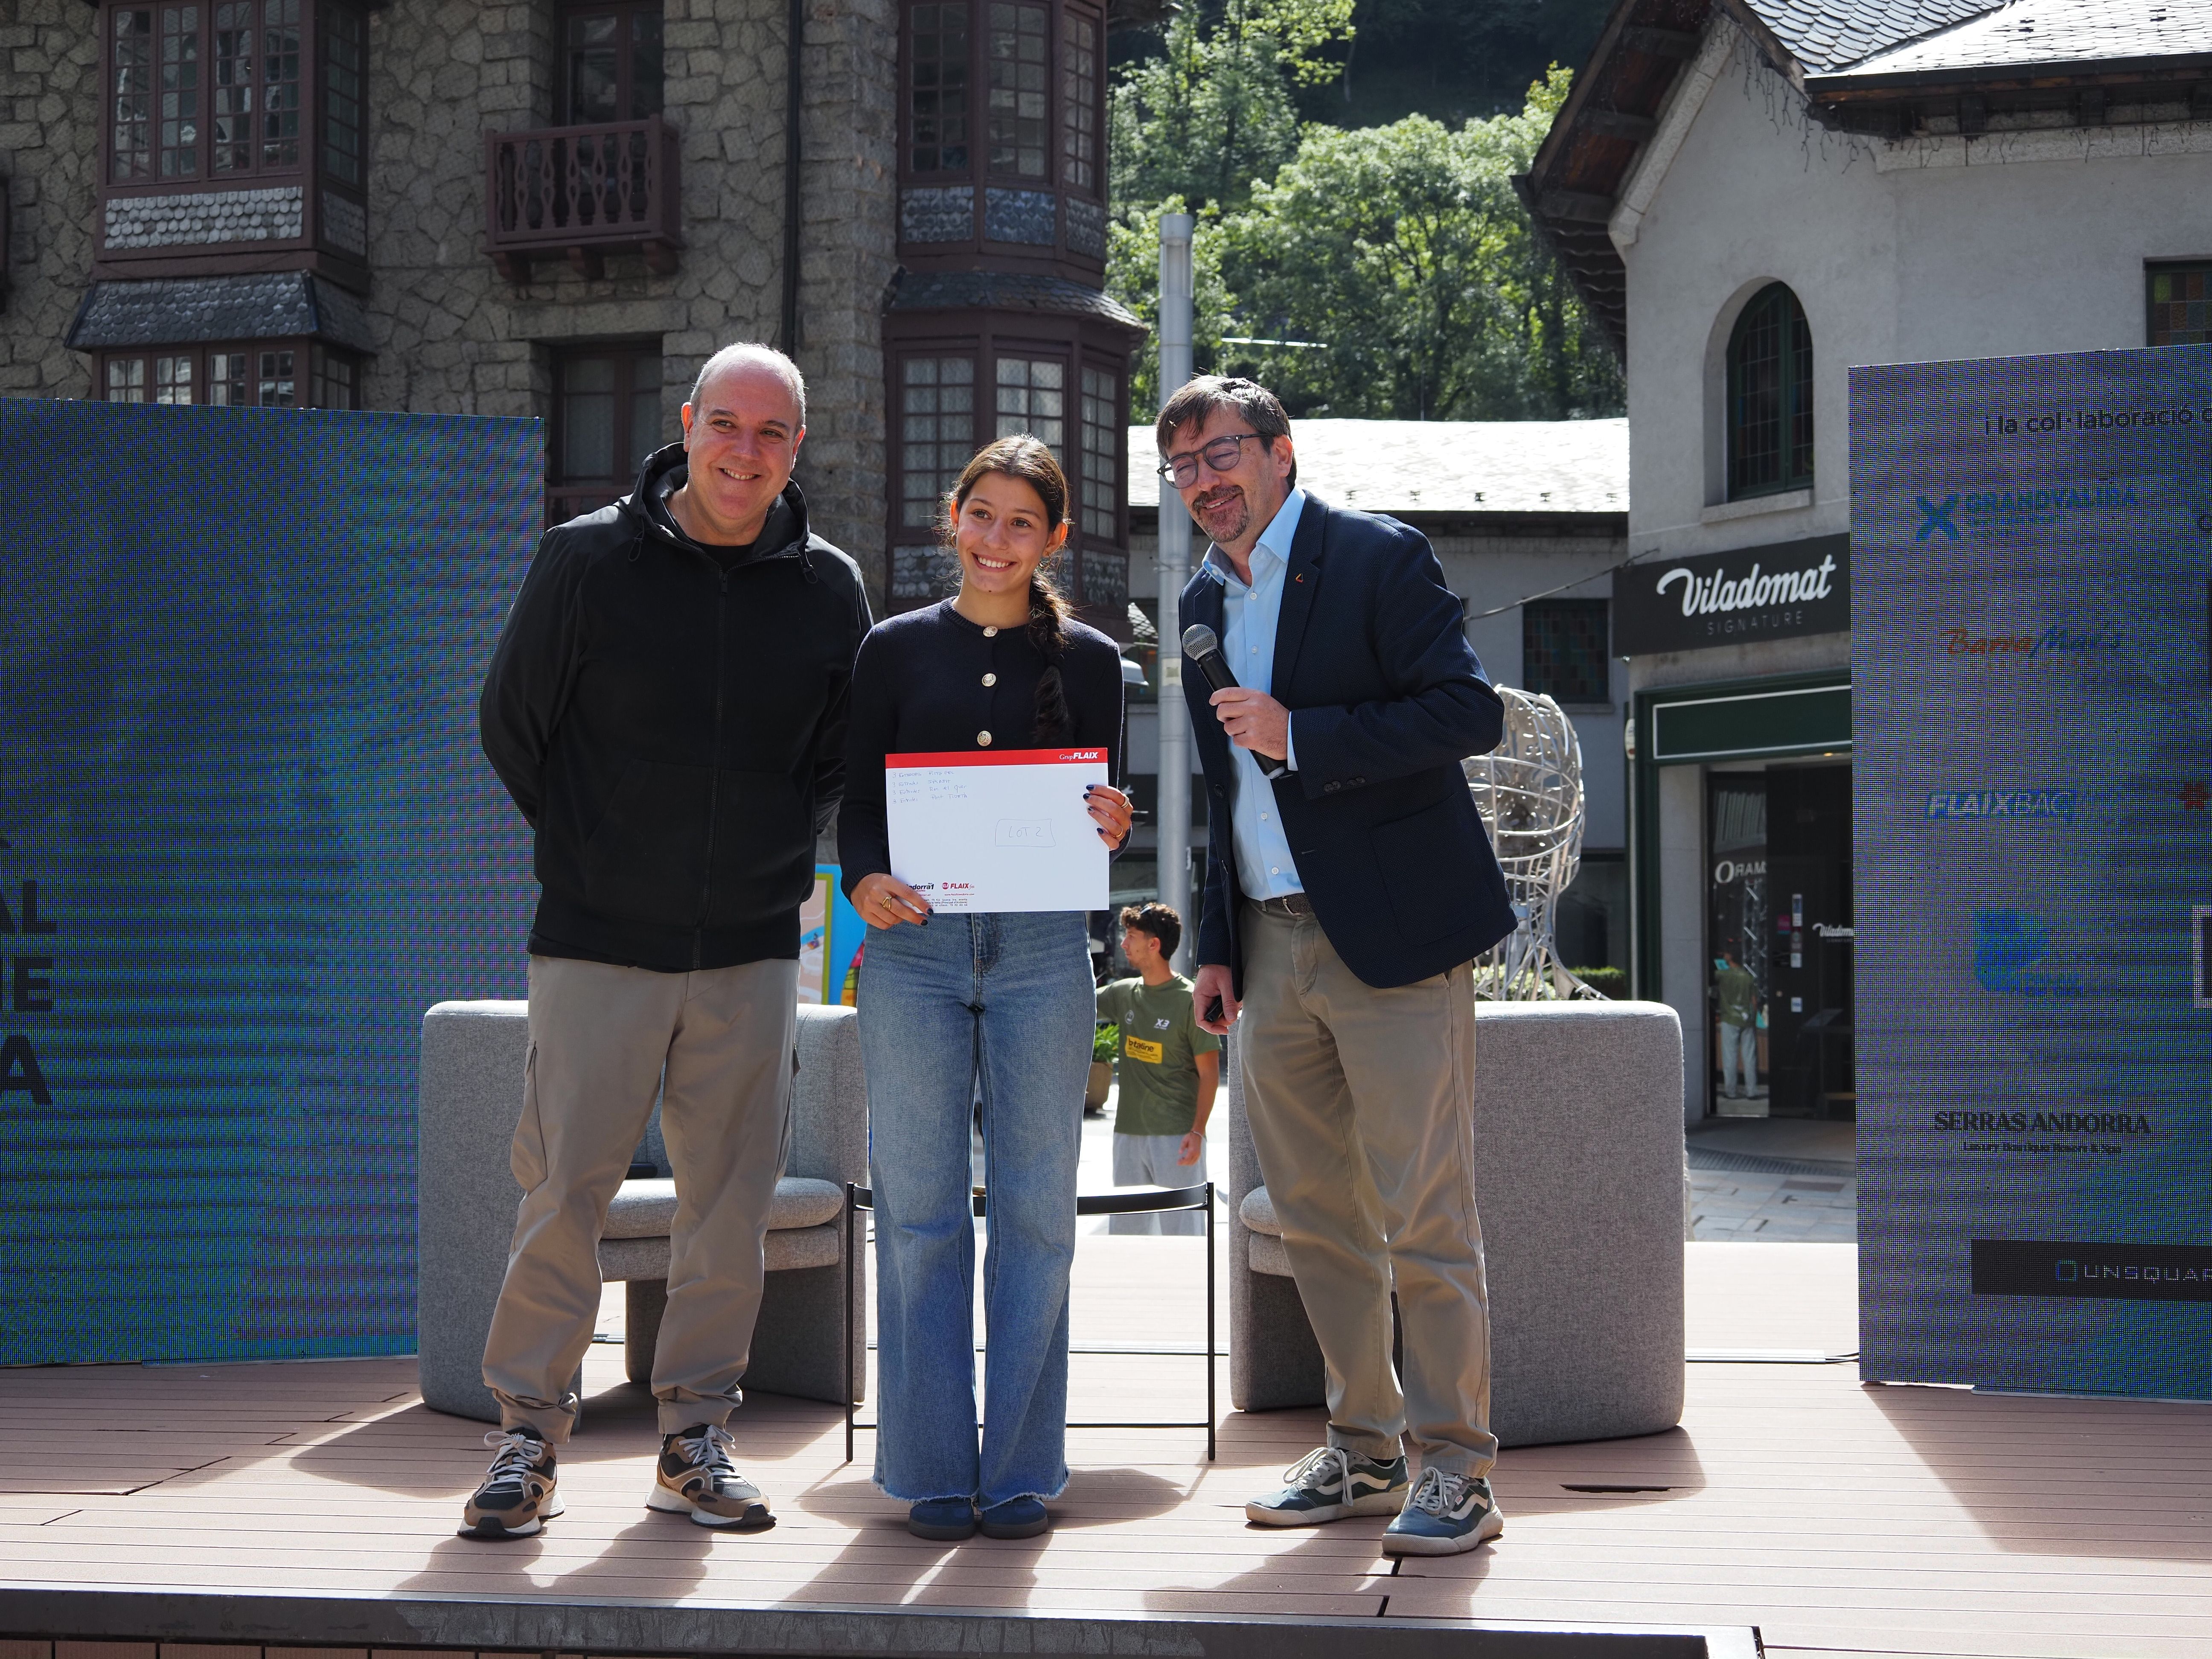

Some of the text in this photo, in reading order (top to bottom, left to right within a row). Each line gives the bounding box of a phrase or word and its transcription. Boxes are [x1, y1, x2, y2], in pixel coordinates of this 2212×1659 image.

[1998, 416, 2017, 434] la
[1964, 486, 2139, 514] GRANDVALIRA
[1656, 553, 1837, 617] Viladomat
[1707, 610, 1804, 636] SIGNATURE
[1928, 791, 2072, 816] FLAIXBAC
[1009, 826, 1044, 838] LOT 2
[0, 880, 57, 934] L
[1812, 923, 1854, 937] Viladom
[1155, 1018, 1170, 1027] X3
[1934, 1111, 2151, 1134] SERRAS ANDORRA
